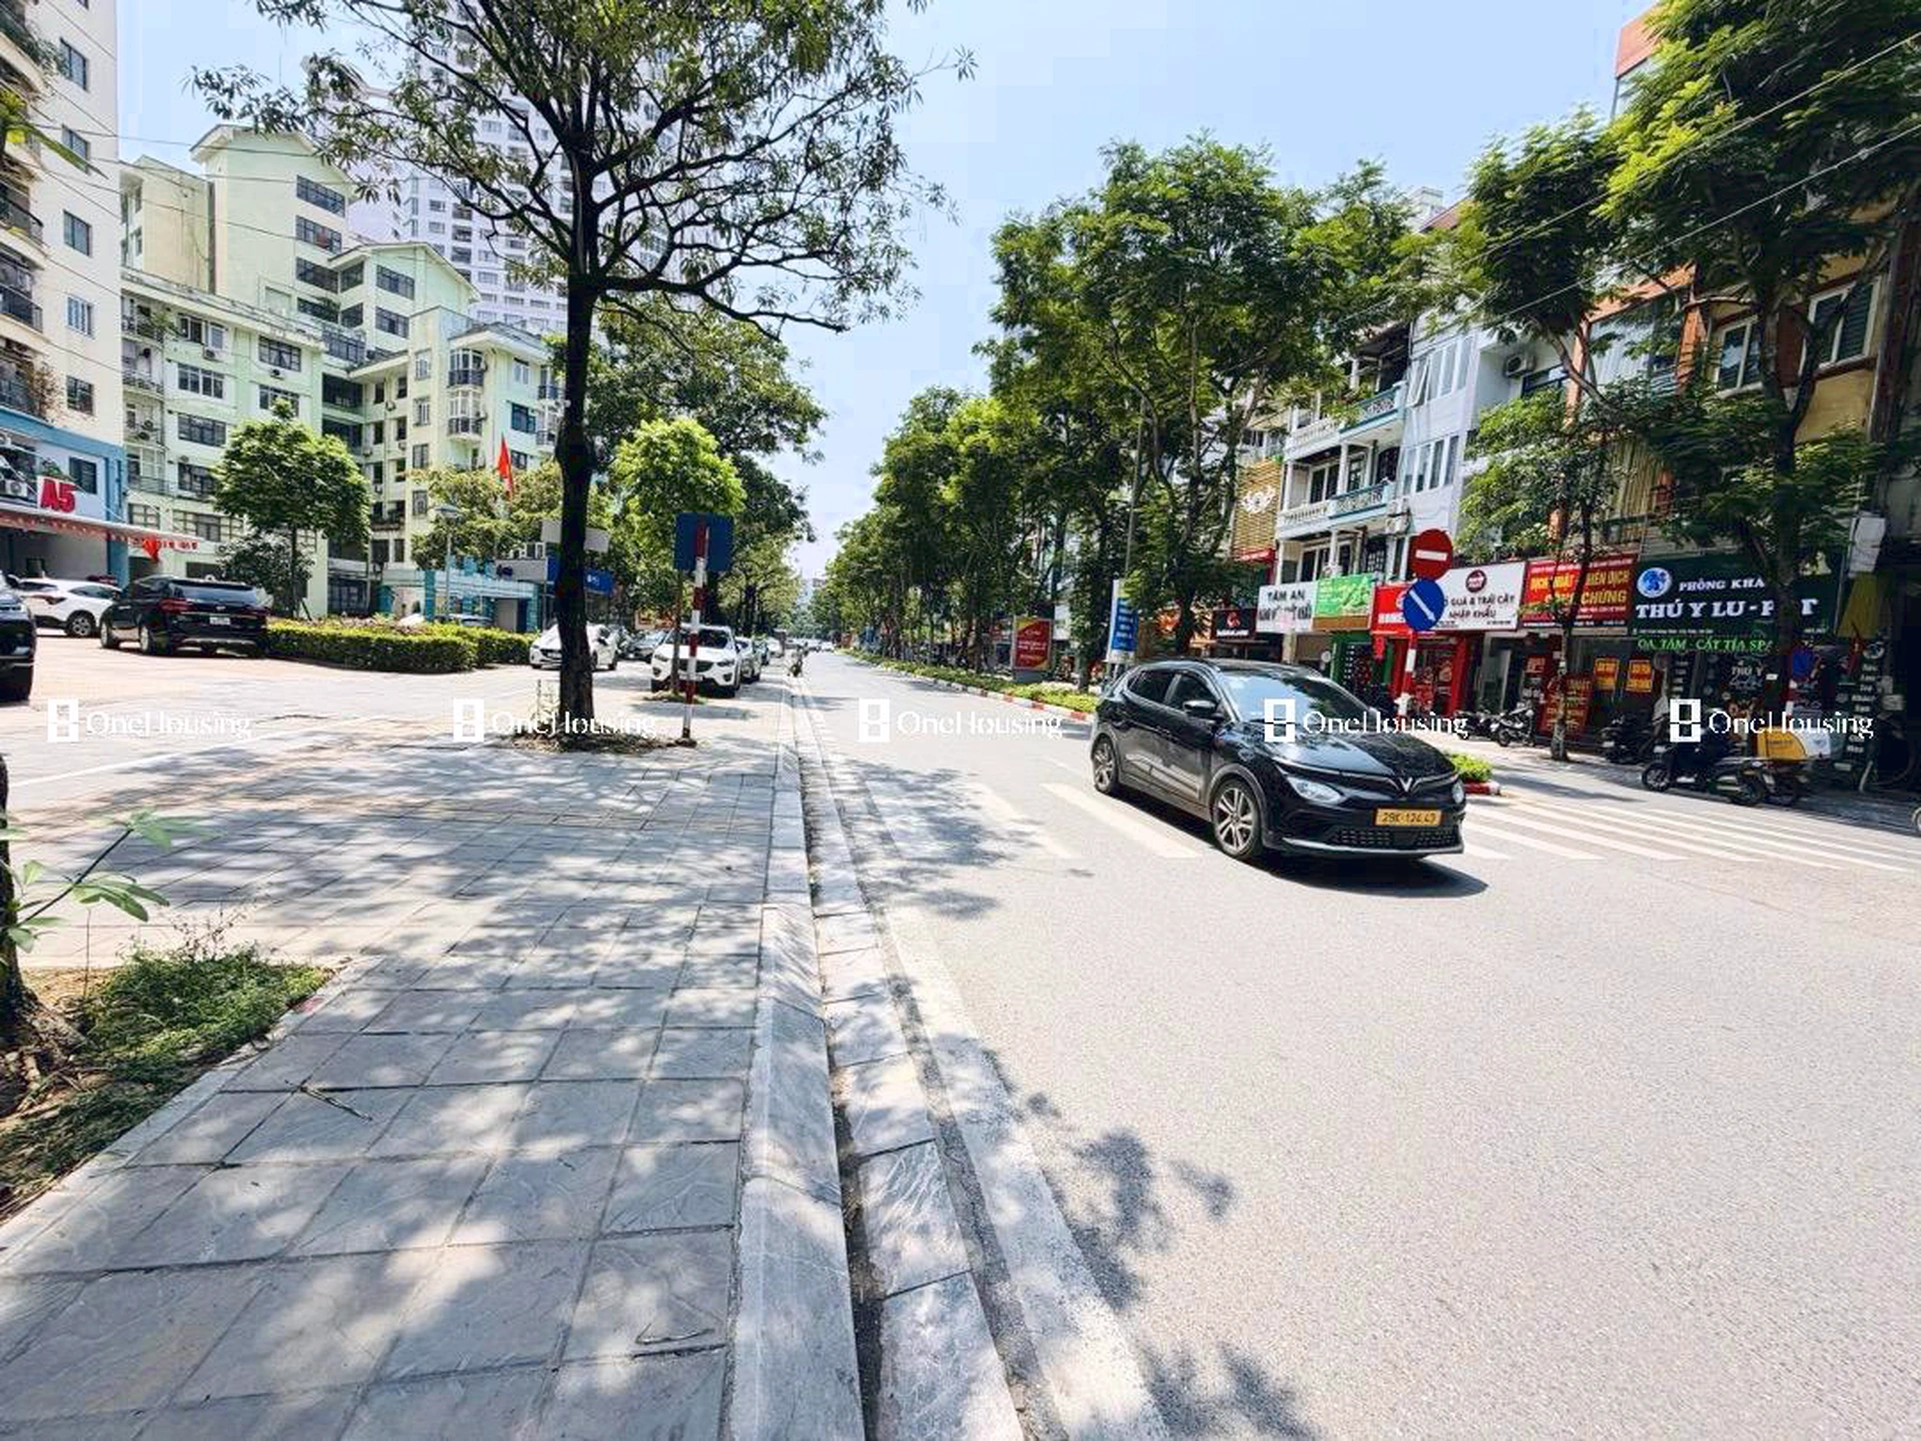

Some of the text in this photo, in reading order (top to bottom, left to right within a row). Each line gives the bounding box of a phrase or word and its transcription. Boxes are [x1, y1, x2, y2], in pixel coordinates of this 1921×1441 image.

[40, 477, 77, 513] A5
[1580, 588, 1628, 605] CHỨNG
[1635, 599, 1684, 619] THÚ
[1690, 602, 1707, 618] Y
